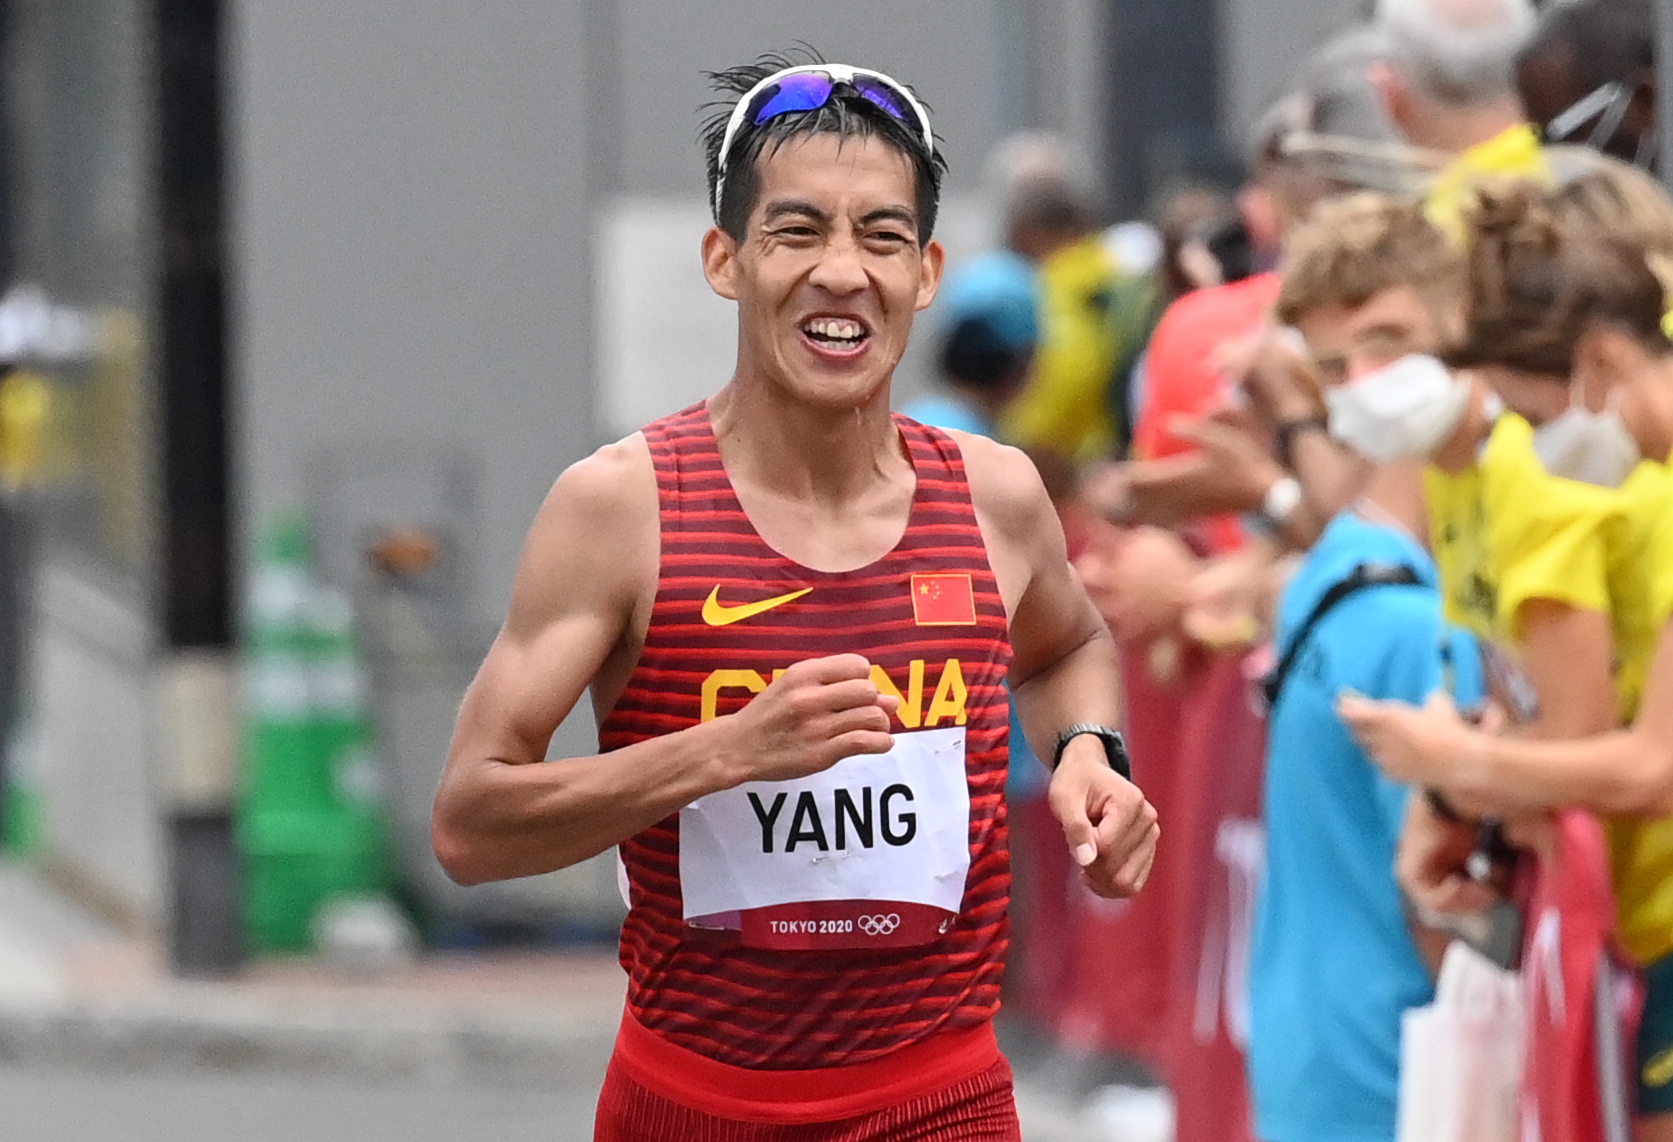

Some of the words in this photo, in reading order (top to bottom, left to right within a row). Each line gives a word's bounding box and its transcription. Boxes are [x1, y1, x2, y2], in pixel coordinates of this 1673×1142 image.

[701, 658, 968, 728] CNA
[746, 783, 917, 853] YANG
[770, 920, 817, 934] TOKYO
[819, 920, 853, 934] 2020
